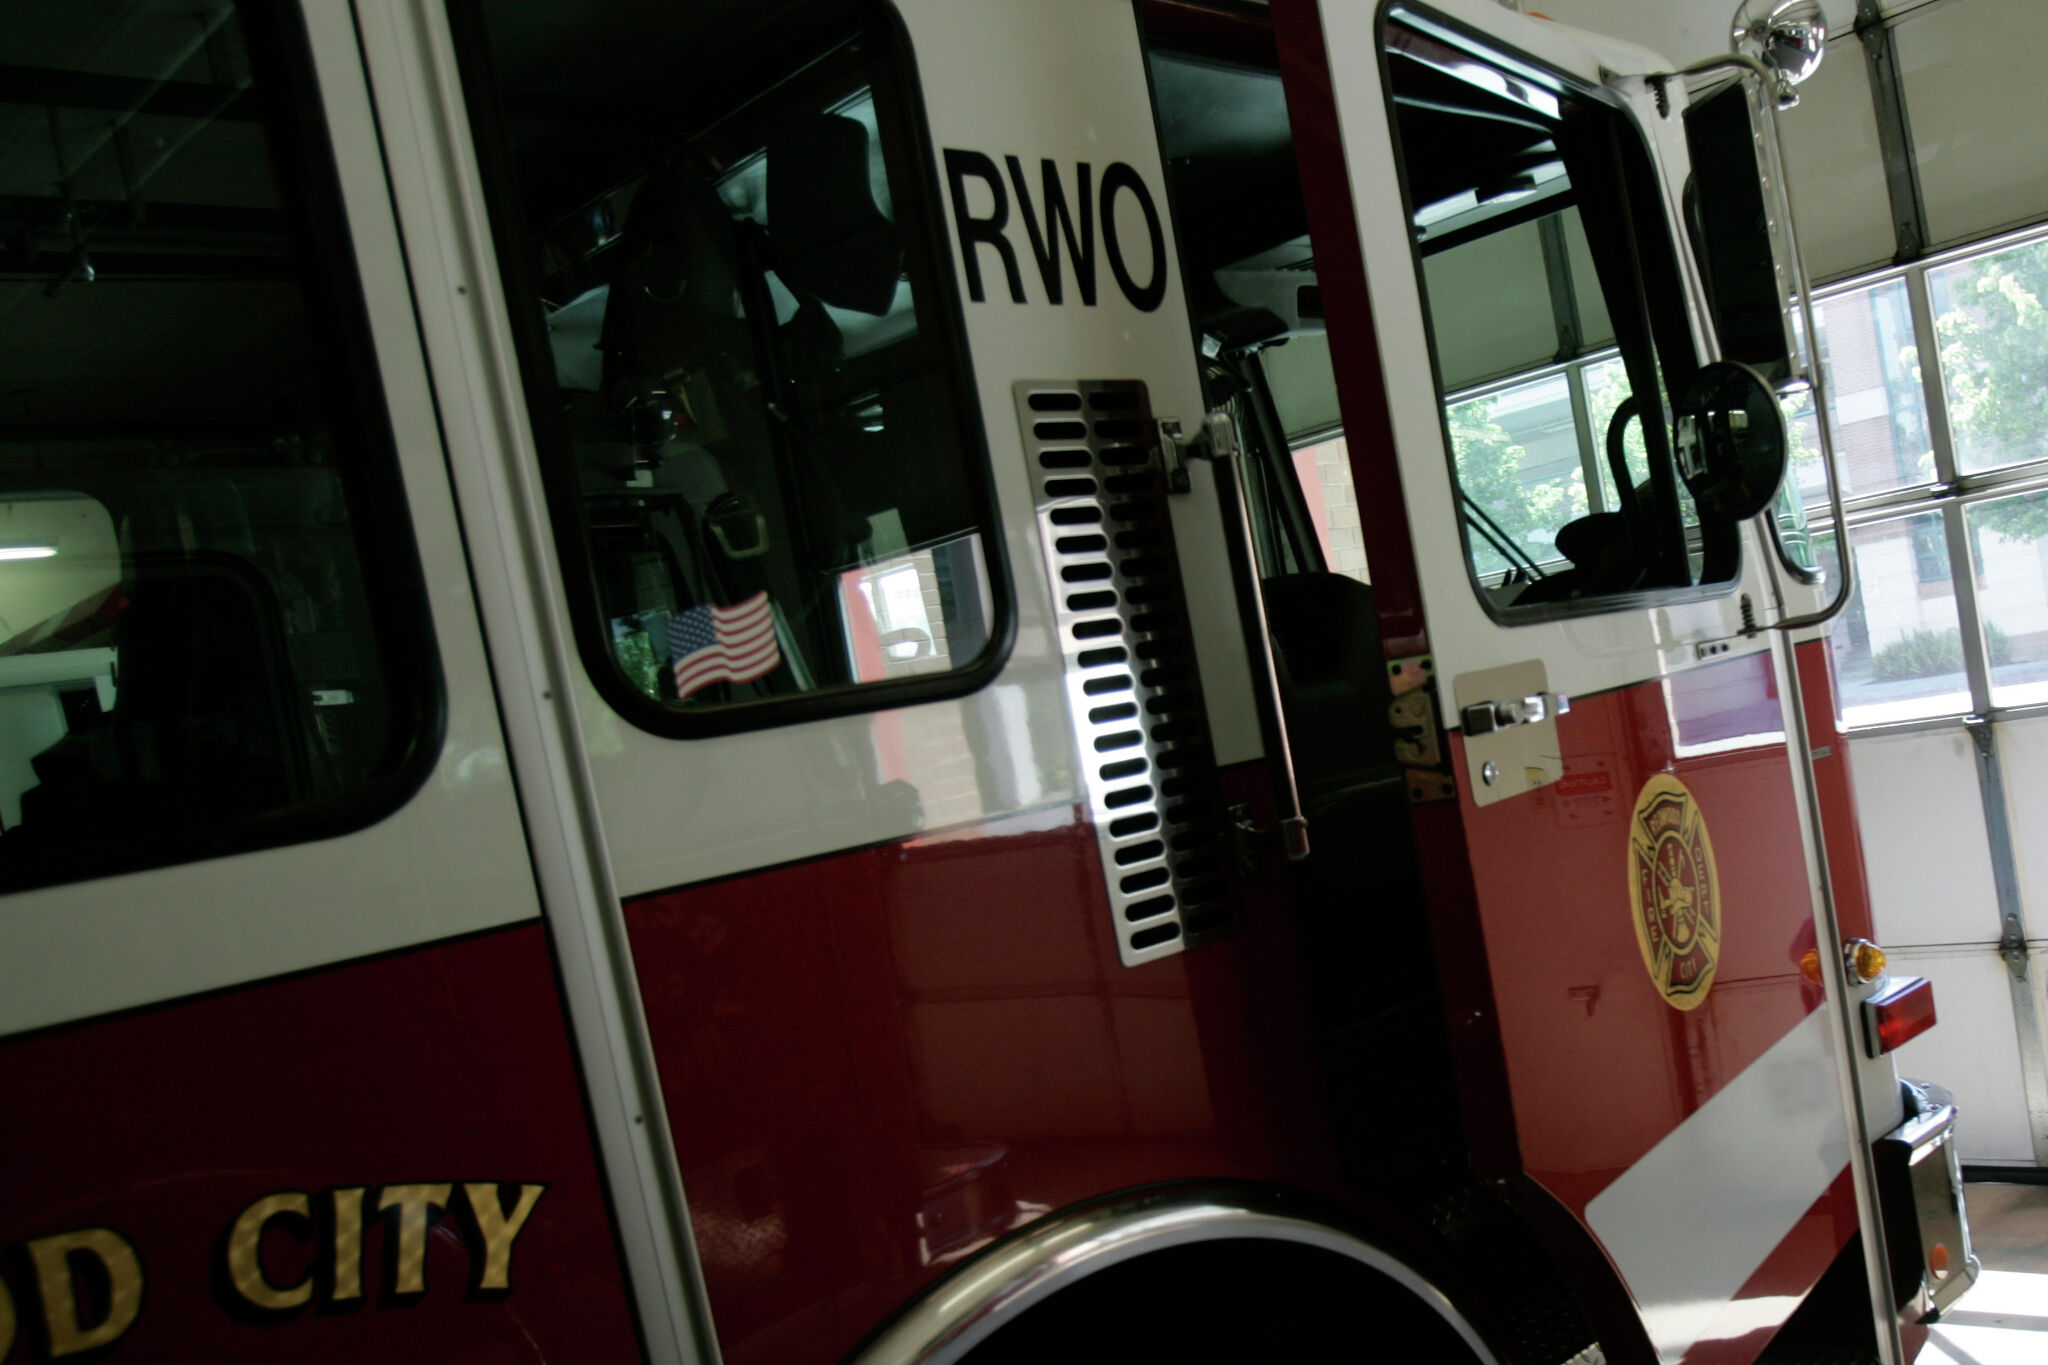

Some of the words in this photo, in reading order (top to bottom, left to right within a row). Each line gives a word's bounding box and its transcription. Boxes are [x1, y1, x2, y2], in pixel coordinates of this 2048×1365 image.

[943, 147, 1167, 313] RWO
[1641, 868, 1658, 942] FIRE
[0, 1226, 144, 1365] D
[224, 1182, 546, 1312] CITY
